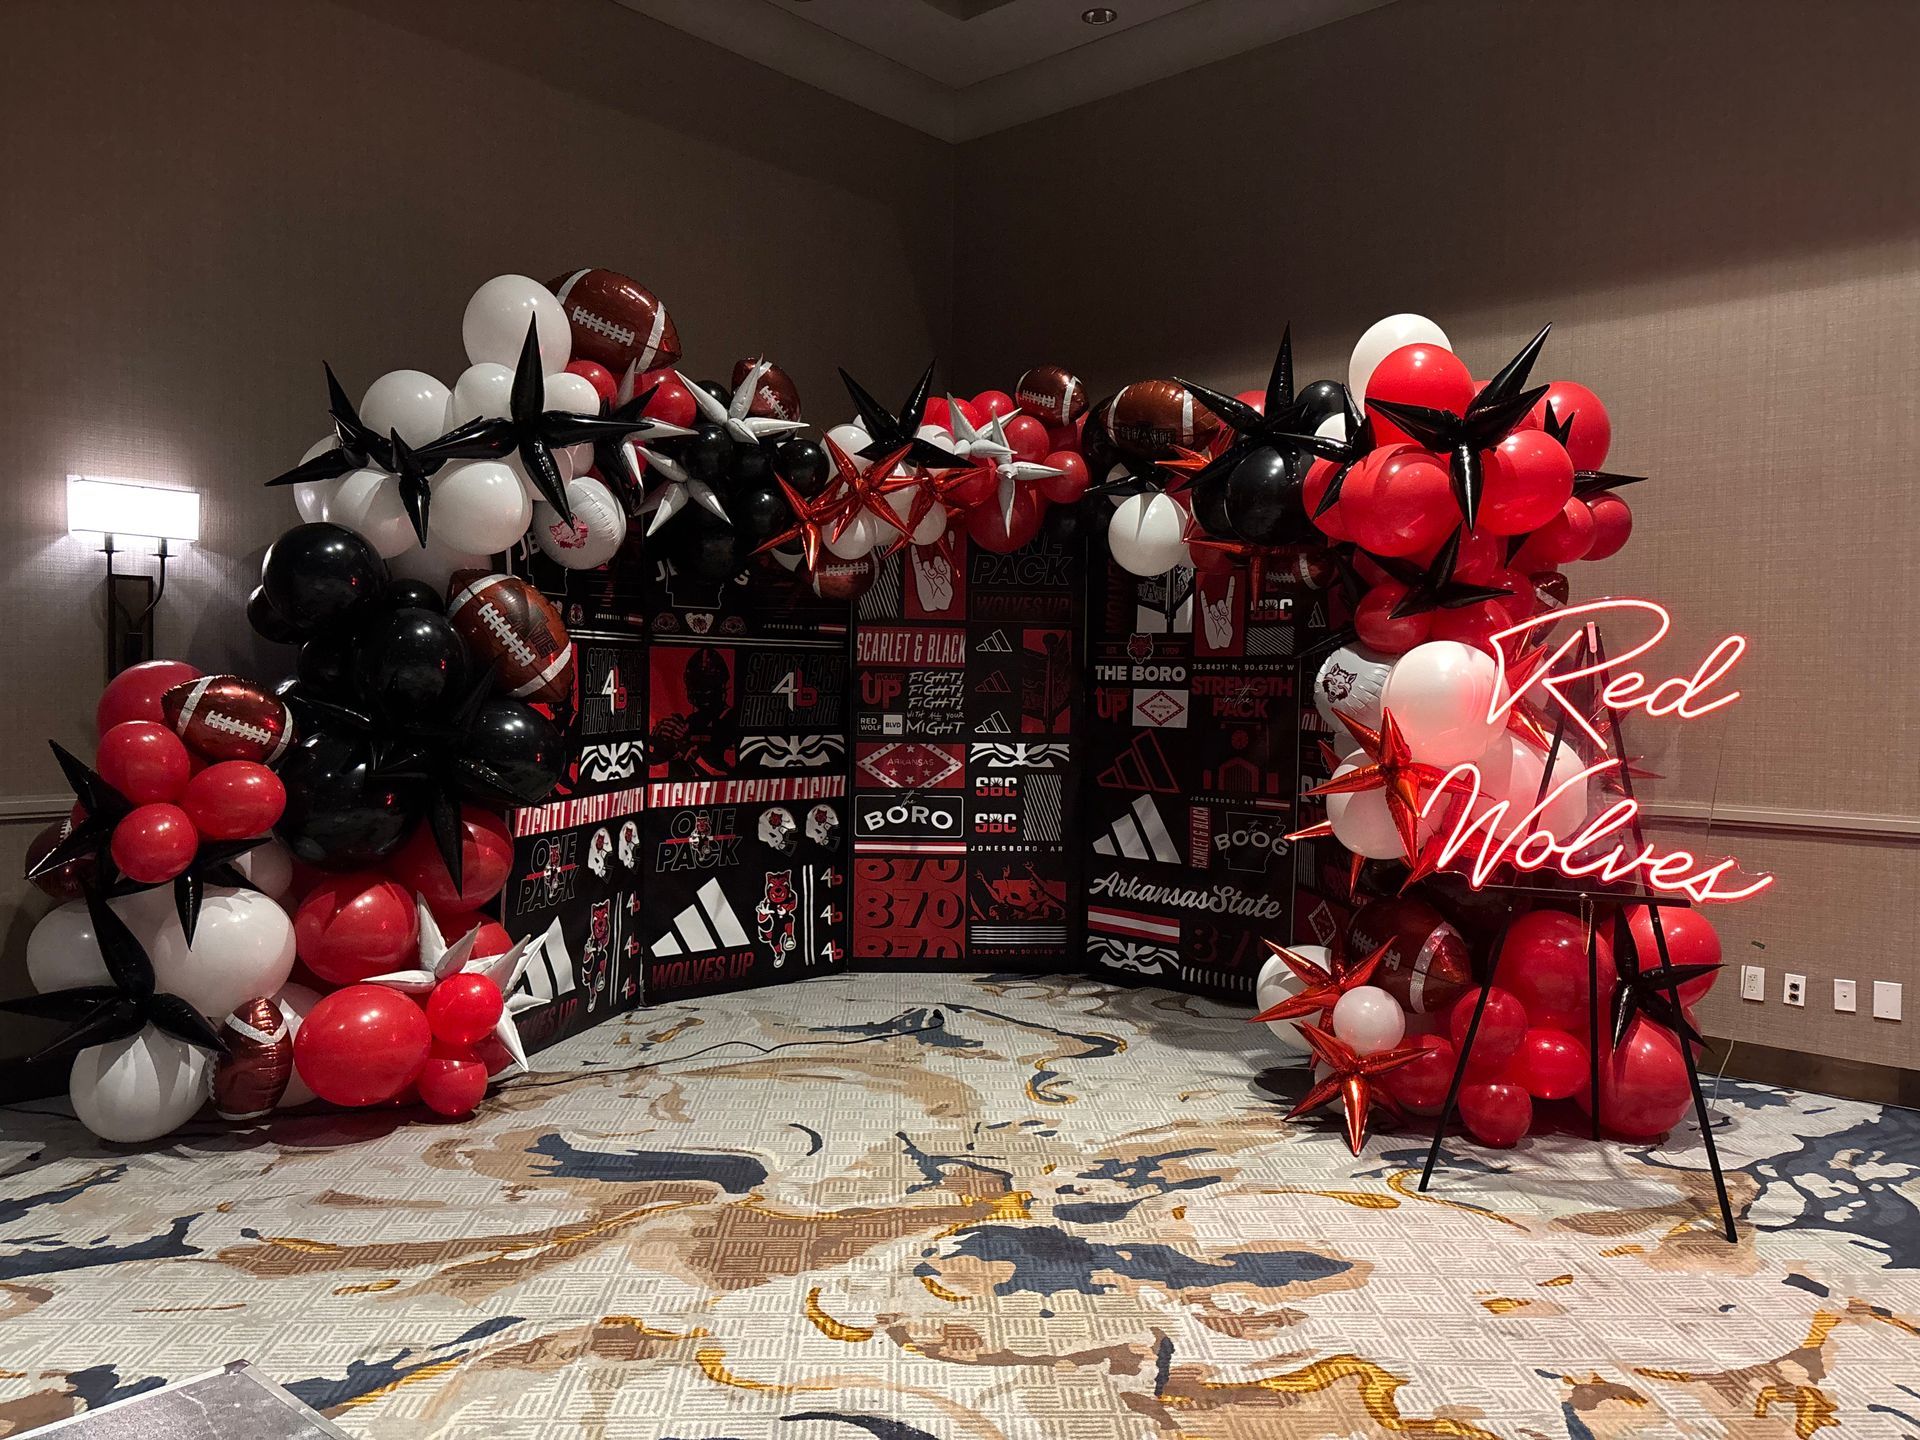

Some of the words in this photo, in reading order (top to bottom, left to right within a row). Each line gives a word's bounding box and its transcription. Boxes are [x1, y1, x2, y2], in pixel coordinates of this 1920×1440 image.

[972, 554, 1073, 585] PACK
[857, 632, 909, 664] SCARLET
[914, 633, 925, 663] &
[927, 633, 966, 664] BLACK
[908, 671, 965, 685] FIGHT!
[1095, 665, 1128, 681] THE
[1132, 665, 1187, 683] BORO
[1190, 676, 1294, 697] STRENGTH
[1487, 600, 1746, 750] Red
[859, 670, 903, 710] UP
[908, 684, 965, 698] FIGHT!
[907, 697, 965, 711] FIGHT!
[946, 711, 965, 720] YOUR
[1097, 687, 1128, 722] UP
[1212, 697, 1270, 718] PACK
[860, 717, 877, 725] RED
[906, 720, 966, 736] MIGHT
[887, 758, 935, 767] ARKANSAS
[975, 776, 1017, 798] SBC
[671, 808, 737, 841] ONE
[863, 805, 954, 831] BORO
[975, 813, 1017, 834] SBC
[1421, 759, 1773, 901] Wolves
[531, 832, 578, 873] ONE
[656, 836, 743, 872] PACK
[1213, 830, 1290, 856] BOOG
[516, 865, 580, 915] PACK
[856, 888, 964, 929] 870
[651, 956, 727, 990] WOLVES
[729, 951, 756, 978] UP
